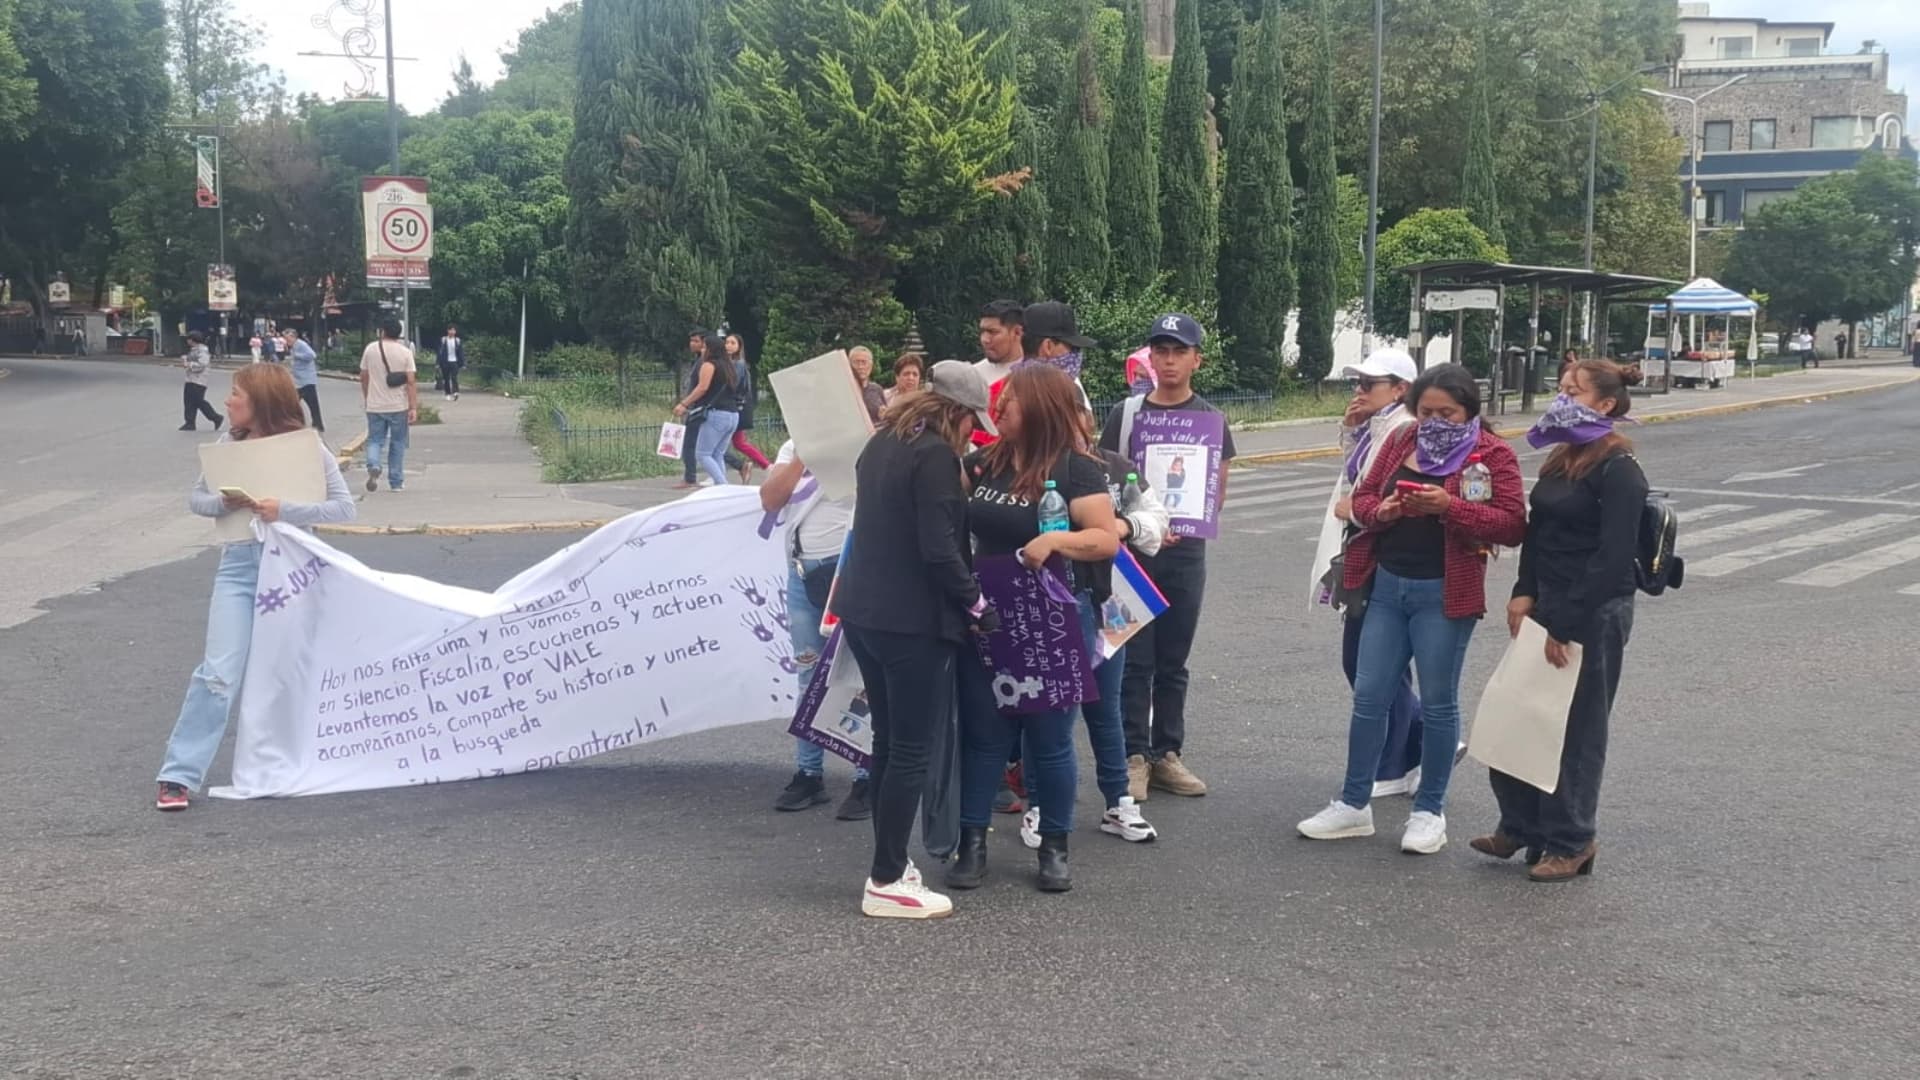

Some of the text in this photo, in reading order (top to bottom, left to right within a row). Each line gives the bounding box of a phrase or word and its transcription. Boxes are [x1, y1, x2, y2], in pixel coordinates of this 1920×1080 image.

[391, 218, 418, 236] 50
[974, 486, 1030, 507] GUESS
[320, 666, 346, 692] Hoy
[354, 660, 384, 682] nos
[437, 637, 471, 656] una
[499, 624, 519, 638] no
[527, 608, 581, 630] vamos
[591, 600, 602, 613] a
[613, 574, 708, 611] quedarnos
[1014, 596, 1030, 640] VAMOS
[1029, 604, 1041, 622] DE
[1044, 597, 1067, 667] LA VOZ
[319, 700, 336, 714] en
[503, 616, 620, 664] escuchenos
[652, 592, 723, 619] actuen
[562, 662, 635, 695] historia
[664, 635, 721, 664] unete
[1023, 647, 1037, 668] NO
[316, 706, 419, 738] Levantemos
[427, 694, 448, 715] la
[544, 641, 603, 673] VALE
[1059, 681, 1071, 699] TE
[397, 713, 542, 769] a la busqueda
